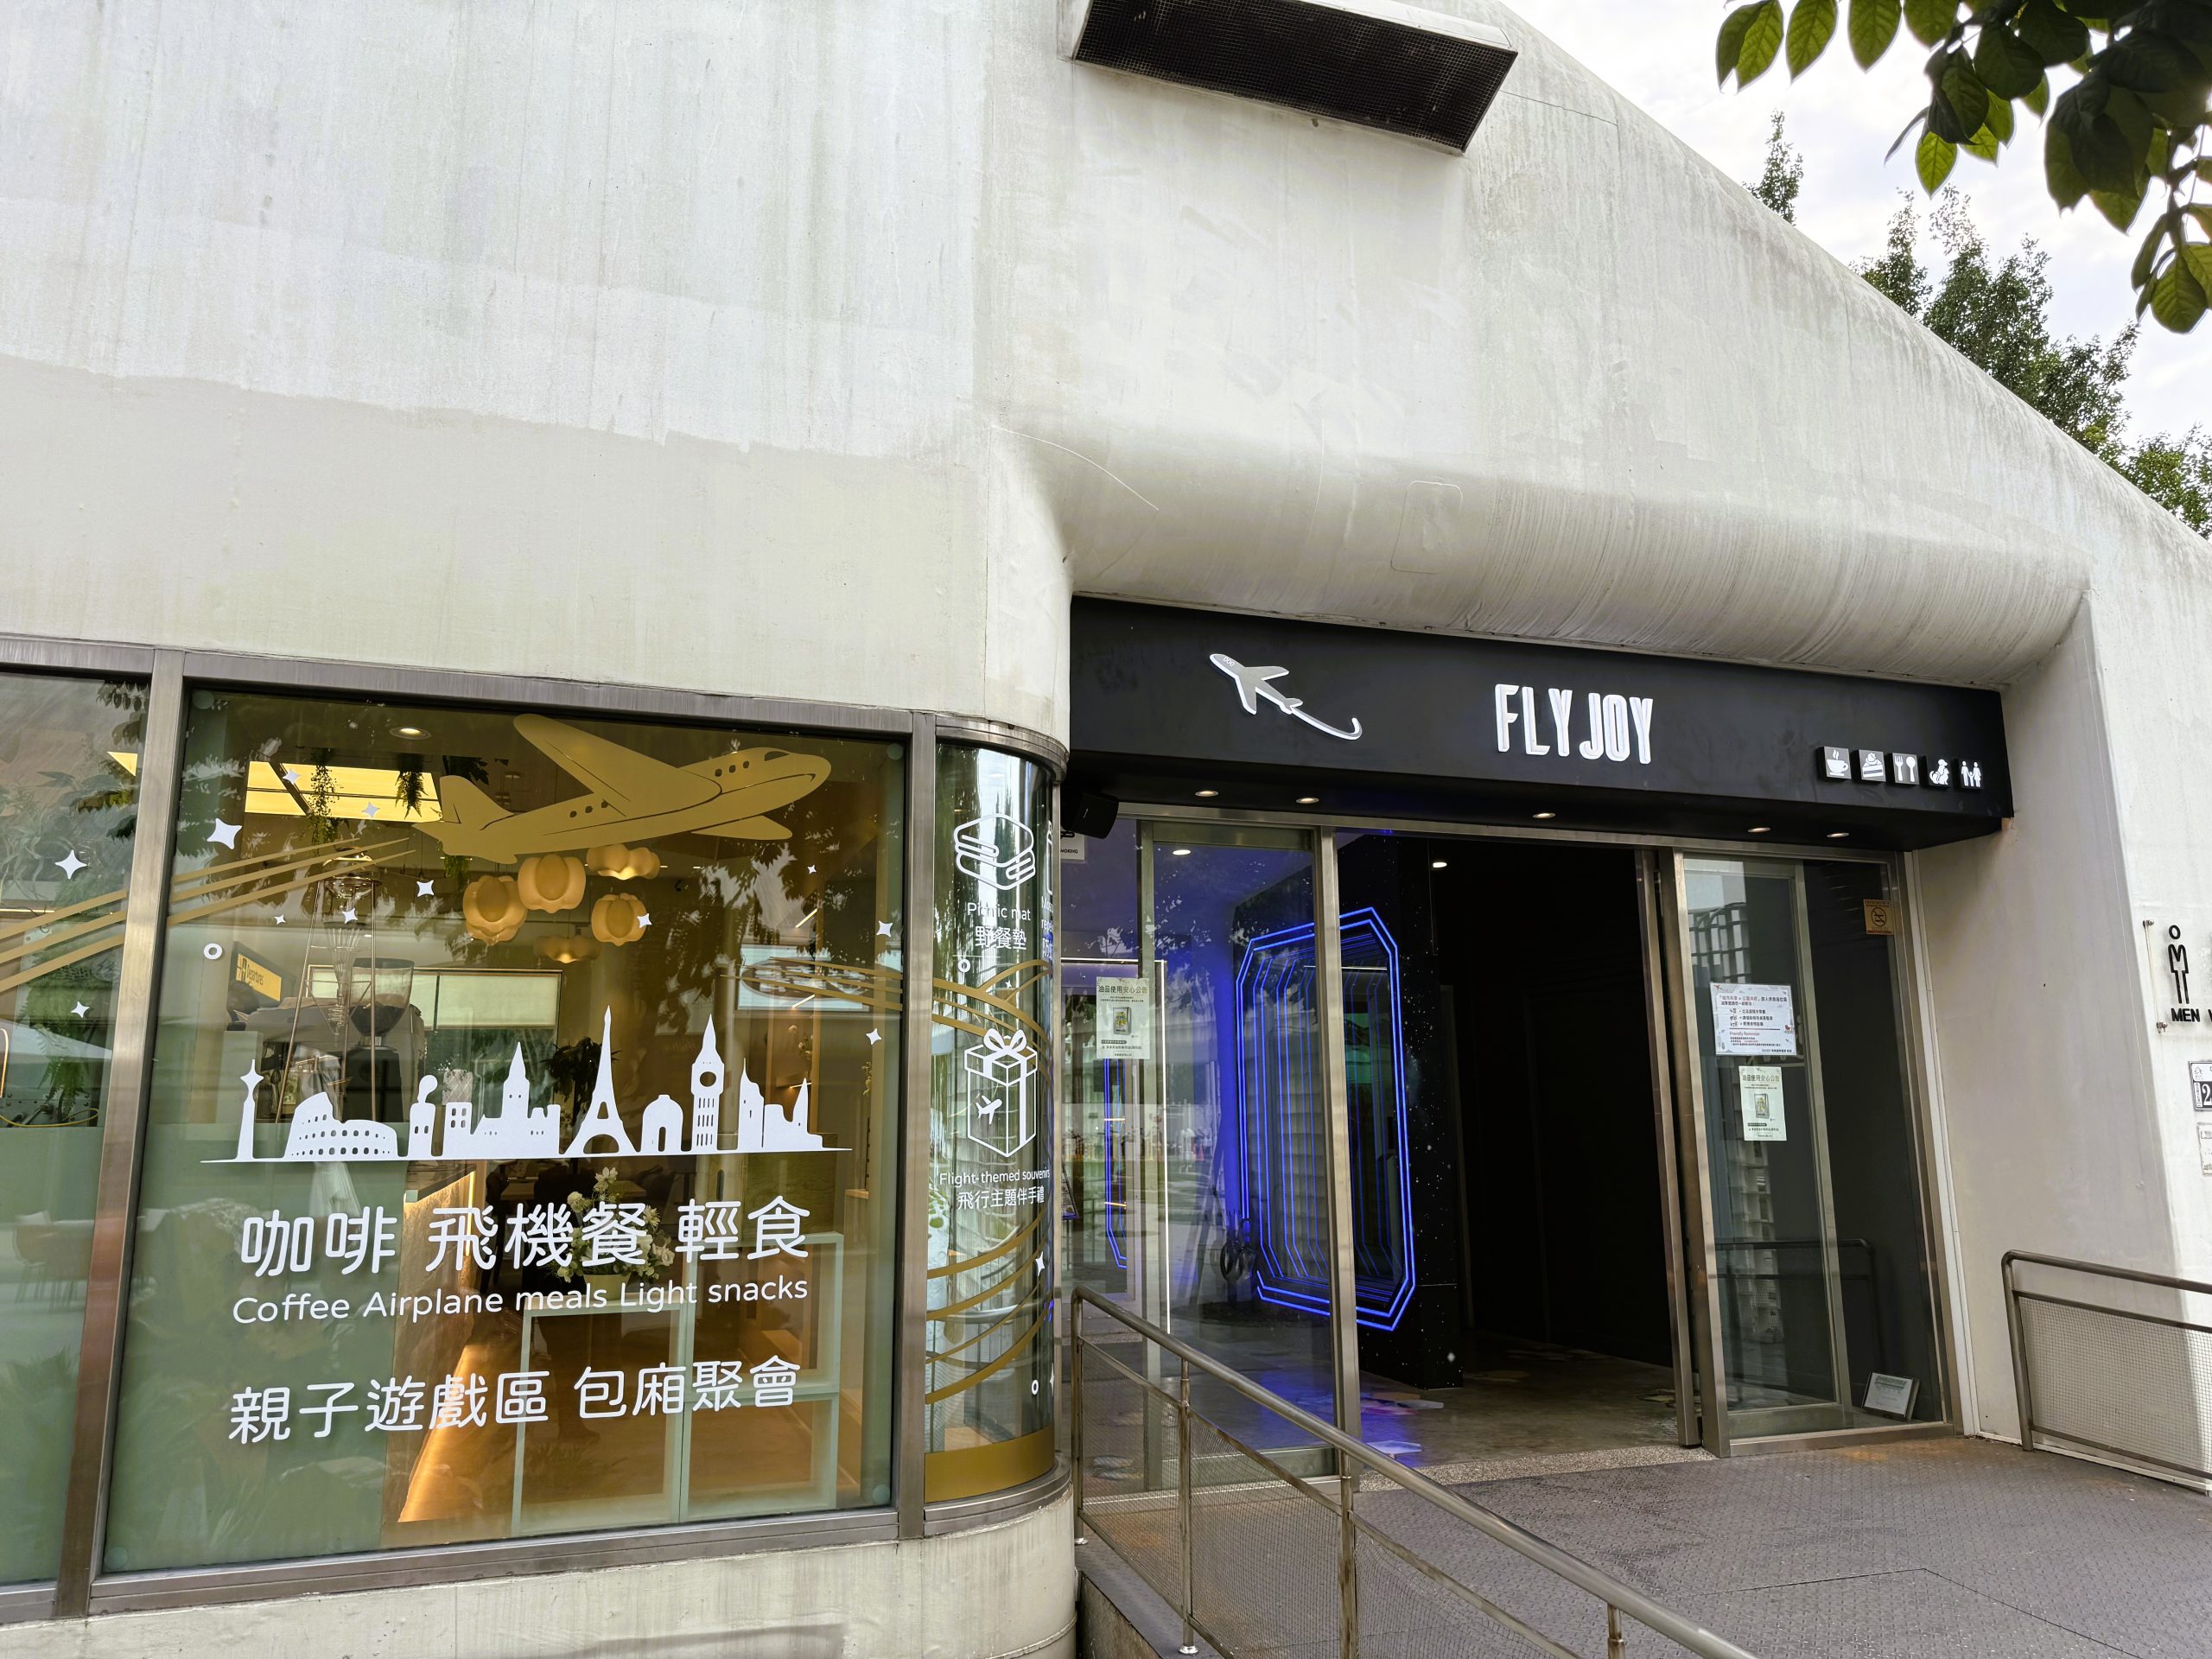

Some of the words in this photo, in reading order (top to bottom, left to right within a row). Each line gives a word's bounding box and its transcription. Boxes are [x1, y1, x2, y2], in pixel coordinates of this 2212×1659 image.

[1495, 683, 1573, 757] FLY
[1579, 692, 1654, 765] JOY
[1011, 907, 1031, 921] mat
[975, 926, 1027, 950] 野餐墊
[2171, 1007, 2201, 1022] MEN
[939, 1169, 1020, 1188] Flight-themed
[1022, 1166, 1051, 1181] souvenirs
[957, 1185, 1045, 1211] 飛行主題伴手禮
[241, 1206, 397, 1277] 咖啡
[426, 1200, 647, 1272] 飛機餐
[675, 1195, 810, 1263] 輕食
[232, 1293, 350, 1324] Coffee
[363, 1288, 503, 1323] Airplane
[516, 1282, 607, 1310] meals
[620, 1280, 697, 1313] Light
[708, 1274, 808, 1303] snacks
[228, 1370, 550, 1444] 親子遊戲區
[574, 1355, 800, 1420] 包廂聚會
